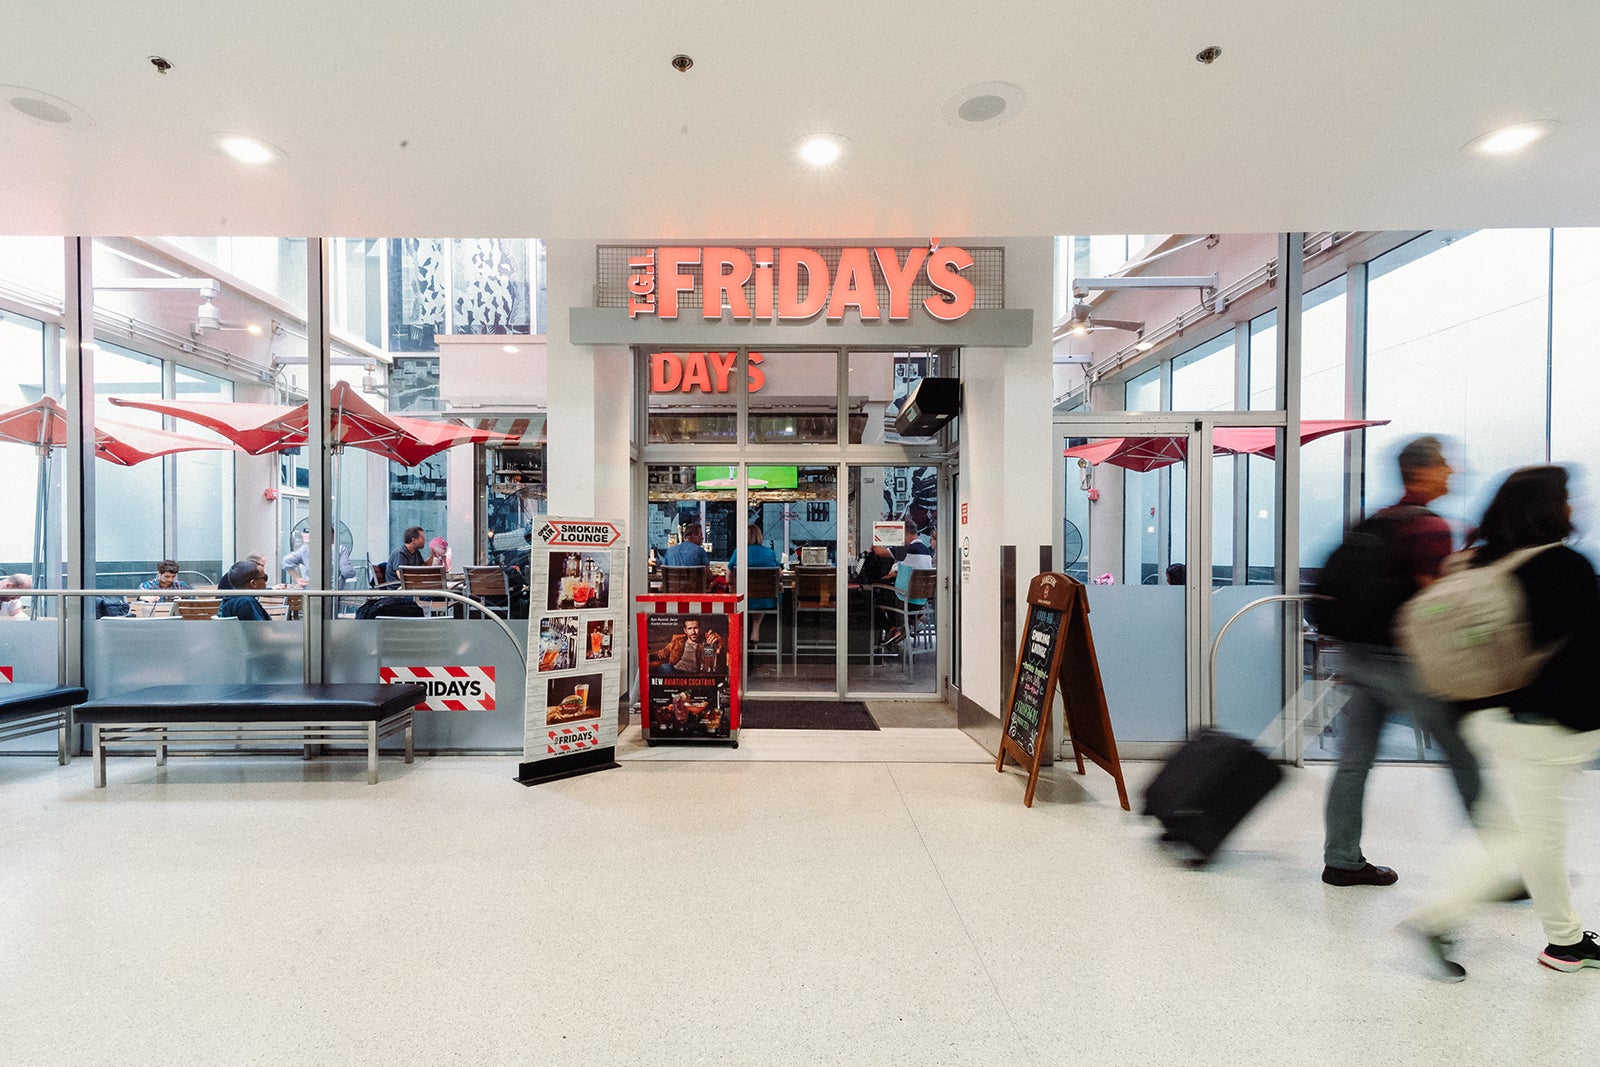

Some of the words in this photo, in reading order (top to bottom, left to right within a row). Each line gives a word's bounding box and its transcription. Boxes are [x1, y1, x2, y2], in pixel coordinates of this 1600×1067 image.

[537, 524, 550, 537] OPEN
[542, 528, 555, 542] AIR
[561, 525, 609, 534] SMOKING
[560, 533, 609, 543] LOUNGE
[651, 677, 664, 686] NEW
[664, 678, 688, 686] AVIATION
[688, 678, 716, 686] COCKTAILS
[559, 731, 592, 745] FRIDAYS
